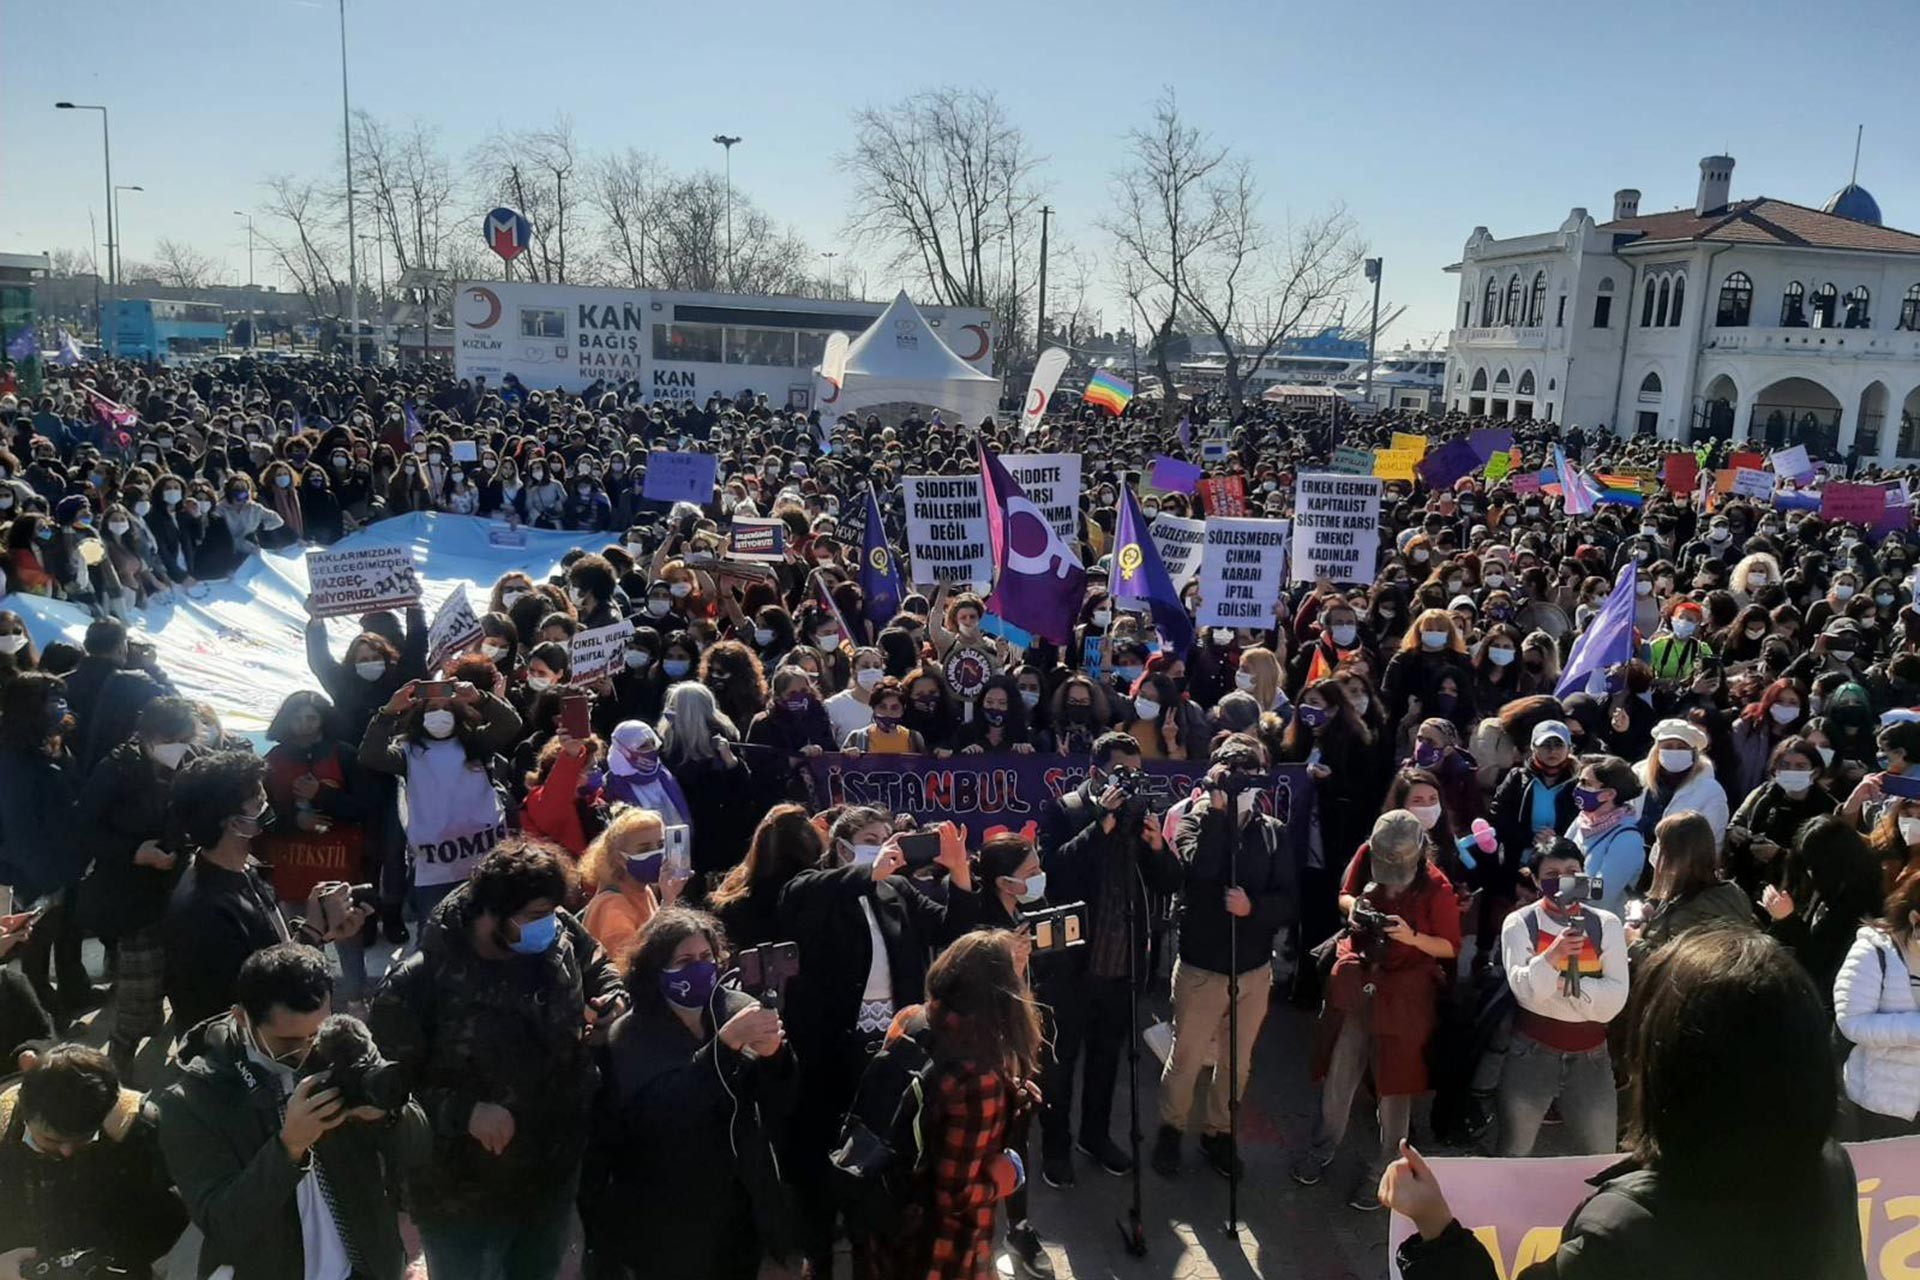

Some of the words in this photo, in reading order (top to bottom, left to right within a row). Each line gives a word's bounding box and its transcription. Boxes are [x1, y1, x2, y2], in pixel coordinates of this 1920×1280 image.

[579, 304, 641, 331] KAN
[462, 339, 503, 350] KIZILAY
[653, 370, 695, 387] KAN
[1302, 480, 1333, 494] ERKEK
[1336, 482, 1378, 496] EGEMEN
[914, 500, 982, 520] FAİLLERİNİ
[1308, 497, 1367, 513] KAPİTALİST
[1297, 513, 1340, 528] SİSTEME
[1343, 517, 1375, 531] KARŞI
[930, 521, 968, 541] DEĞİL
[1208, 529, 1283, 547] SÖZLEŞMEDEN
[1315, 531, 1354, 547] EMEKÇİ
[916, 543, 984, 561] KADINLARI
[1226, 550, 1261, 564] ÇIKMA
[1308, 547, 1359, 562] KADINLAR
[932, 564, 972, 581] KORU!
[1222, 567, 1261, 581] KARARI
[1226, 584, 1254, 599] İPTAL
[1218, 602, 1261, 617] EDİLSİN!
[828, 766, 1031, 816] İSTANBUL
